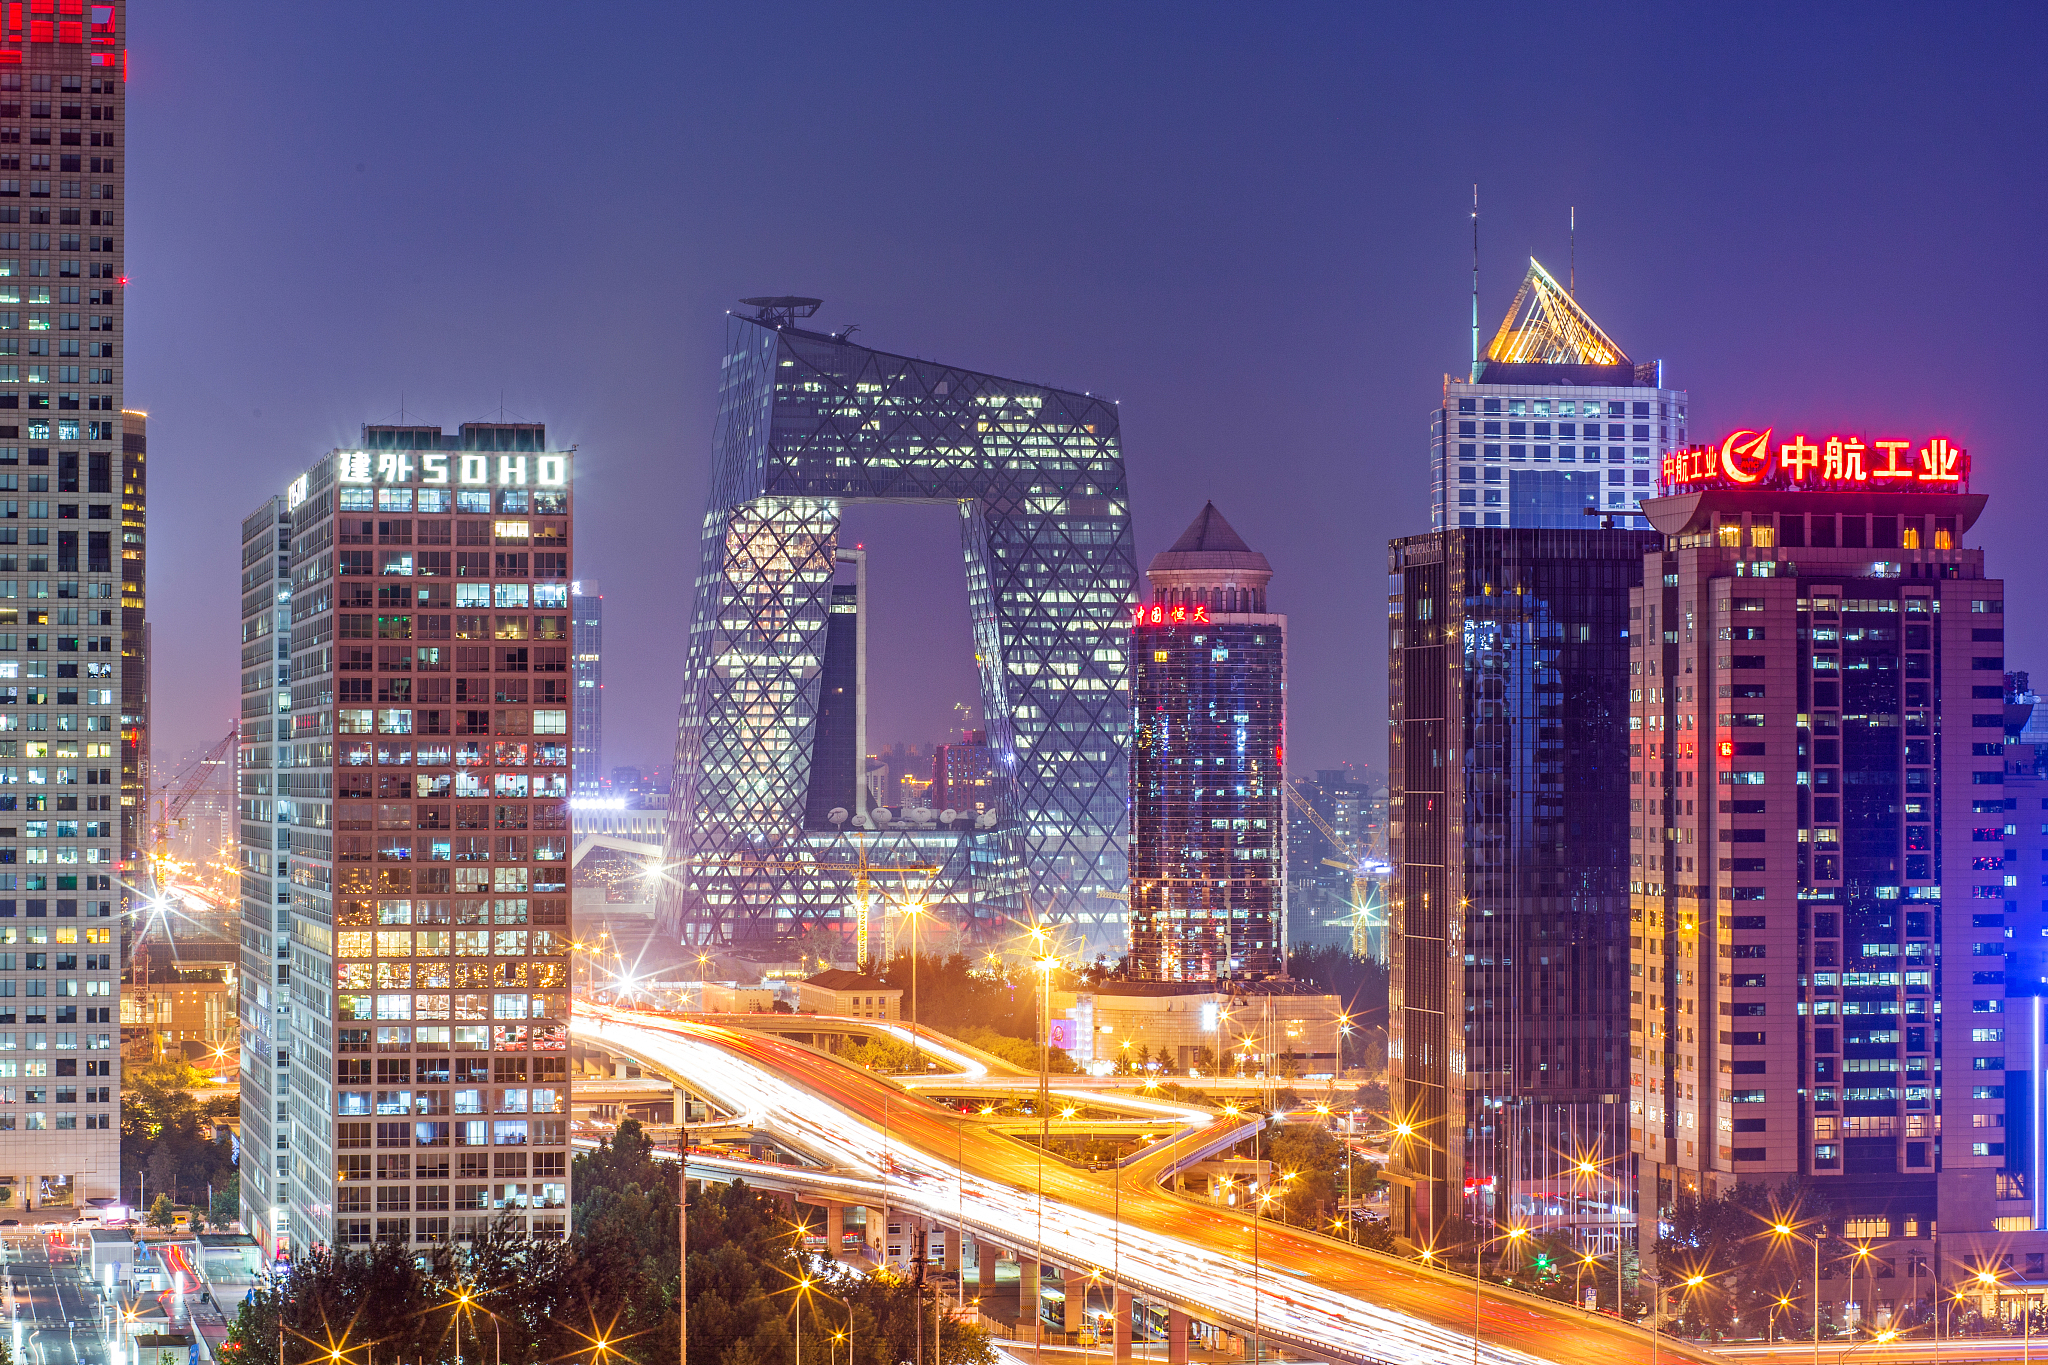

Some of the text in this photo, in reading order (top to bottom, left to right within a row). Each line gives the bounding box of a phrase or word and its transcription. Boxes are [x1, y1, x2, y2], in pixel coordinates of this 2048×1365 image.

[1663, 446, 1717, 485] 中航工业
[1741, 461, 1760, 469] AVIC
[1780, 435, 1959, 481] 中航工业
[1136, 605, 1210, 626] 中国恒天
